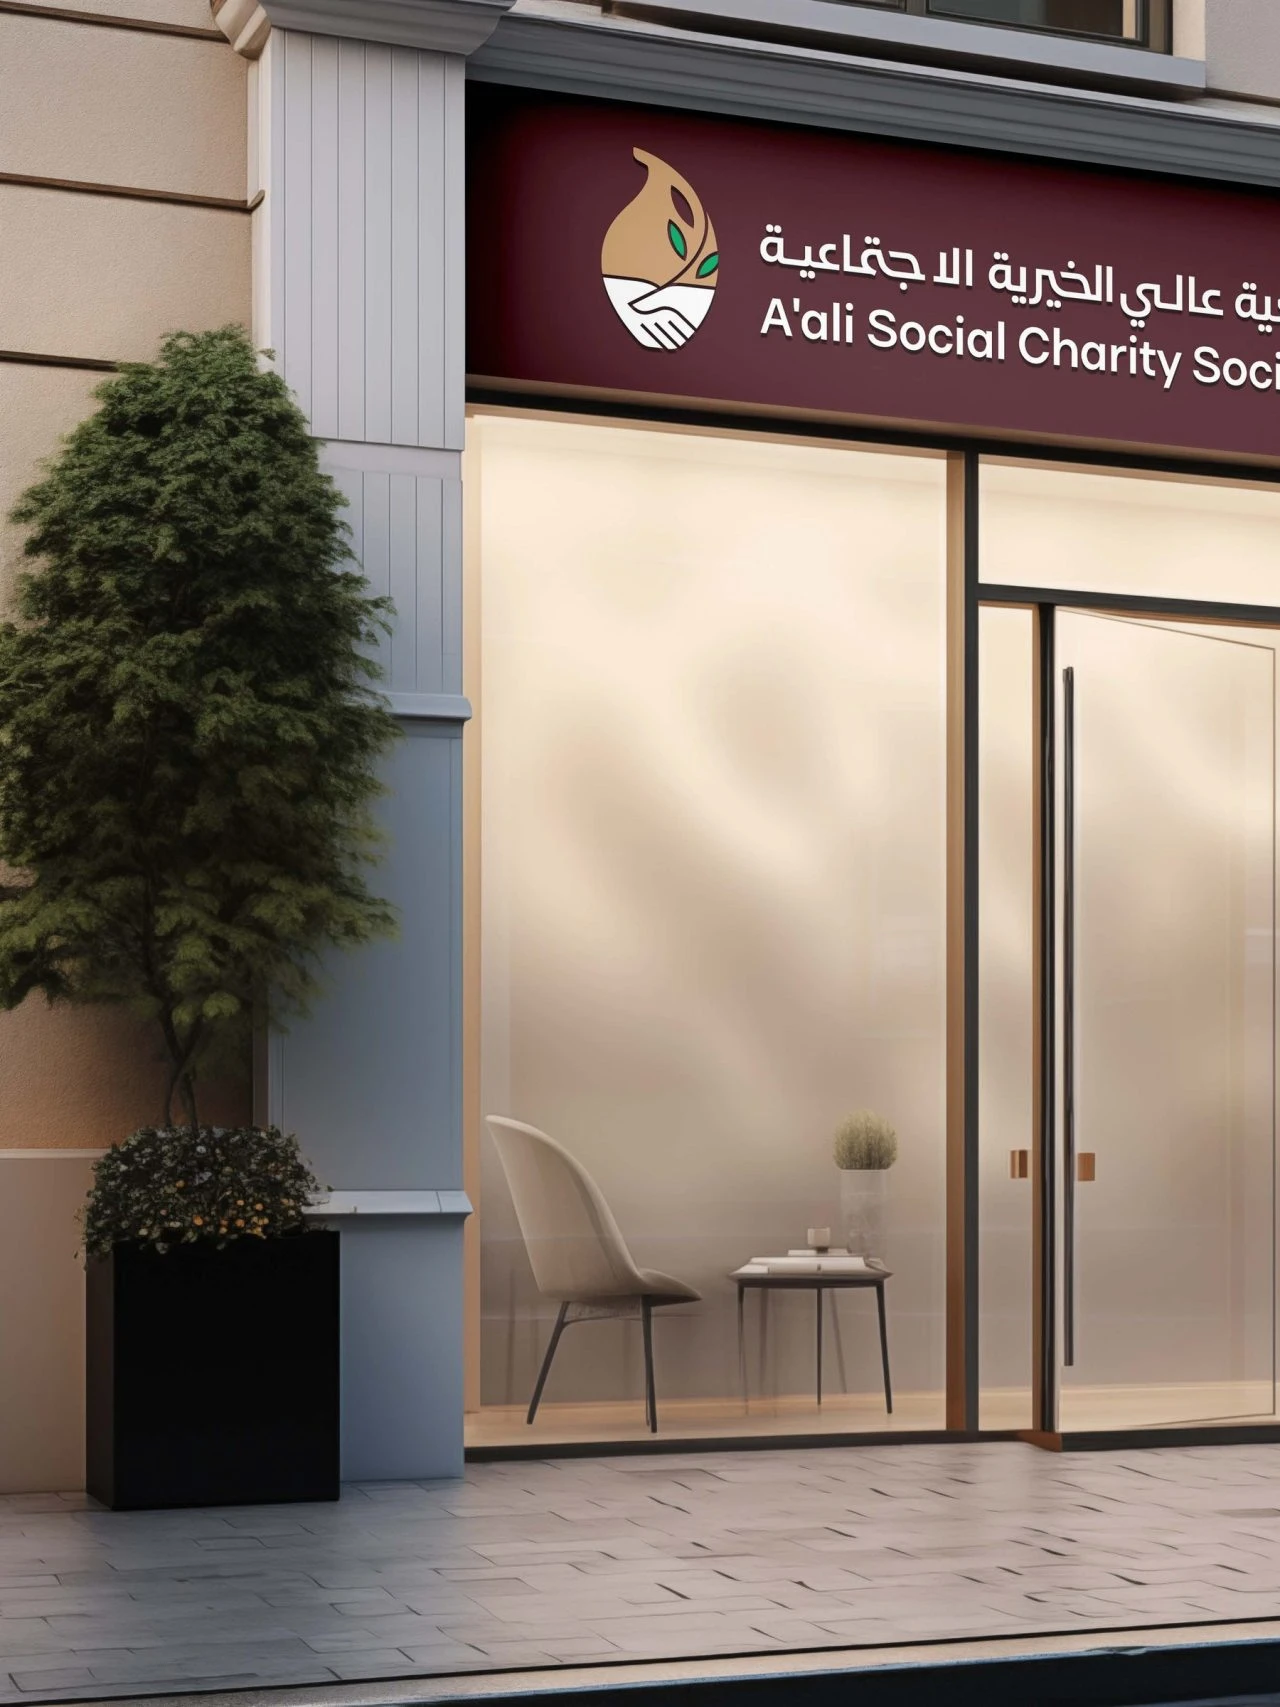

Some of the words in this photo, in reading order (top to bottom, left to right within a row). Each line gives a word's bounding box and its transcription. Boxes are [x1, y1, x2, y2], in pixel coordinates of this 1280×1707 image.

[988, 251, 1114, 309] الخيرية
[1119, 274, 1224, 329] عالي
[760, 297, 854, 344] A'ali
[867, 308, 1005, 360] Social
[1018, 326, 1183, 389] Charity
